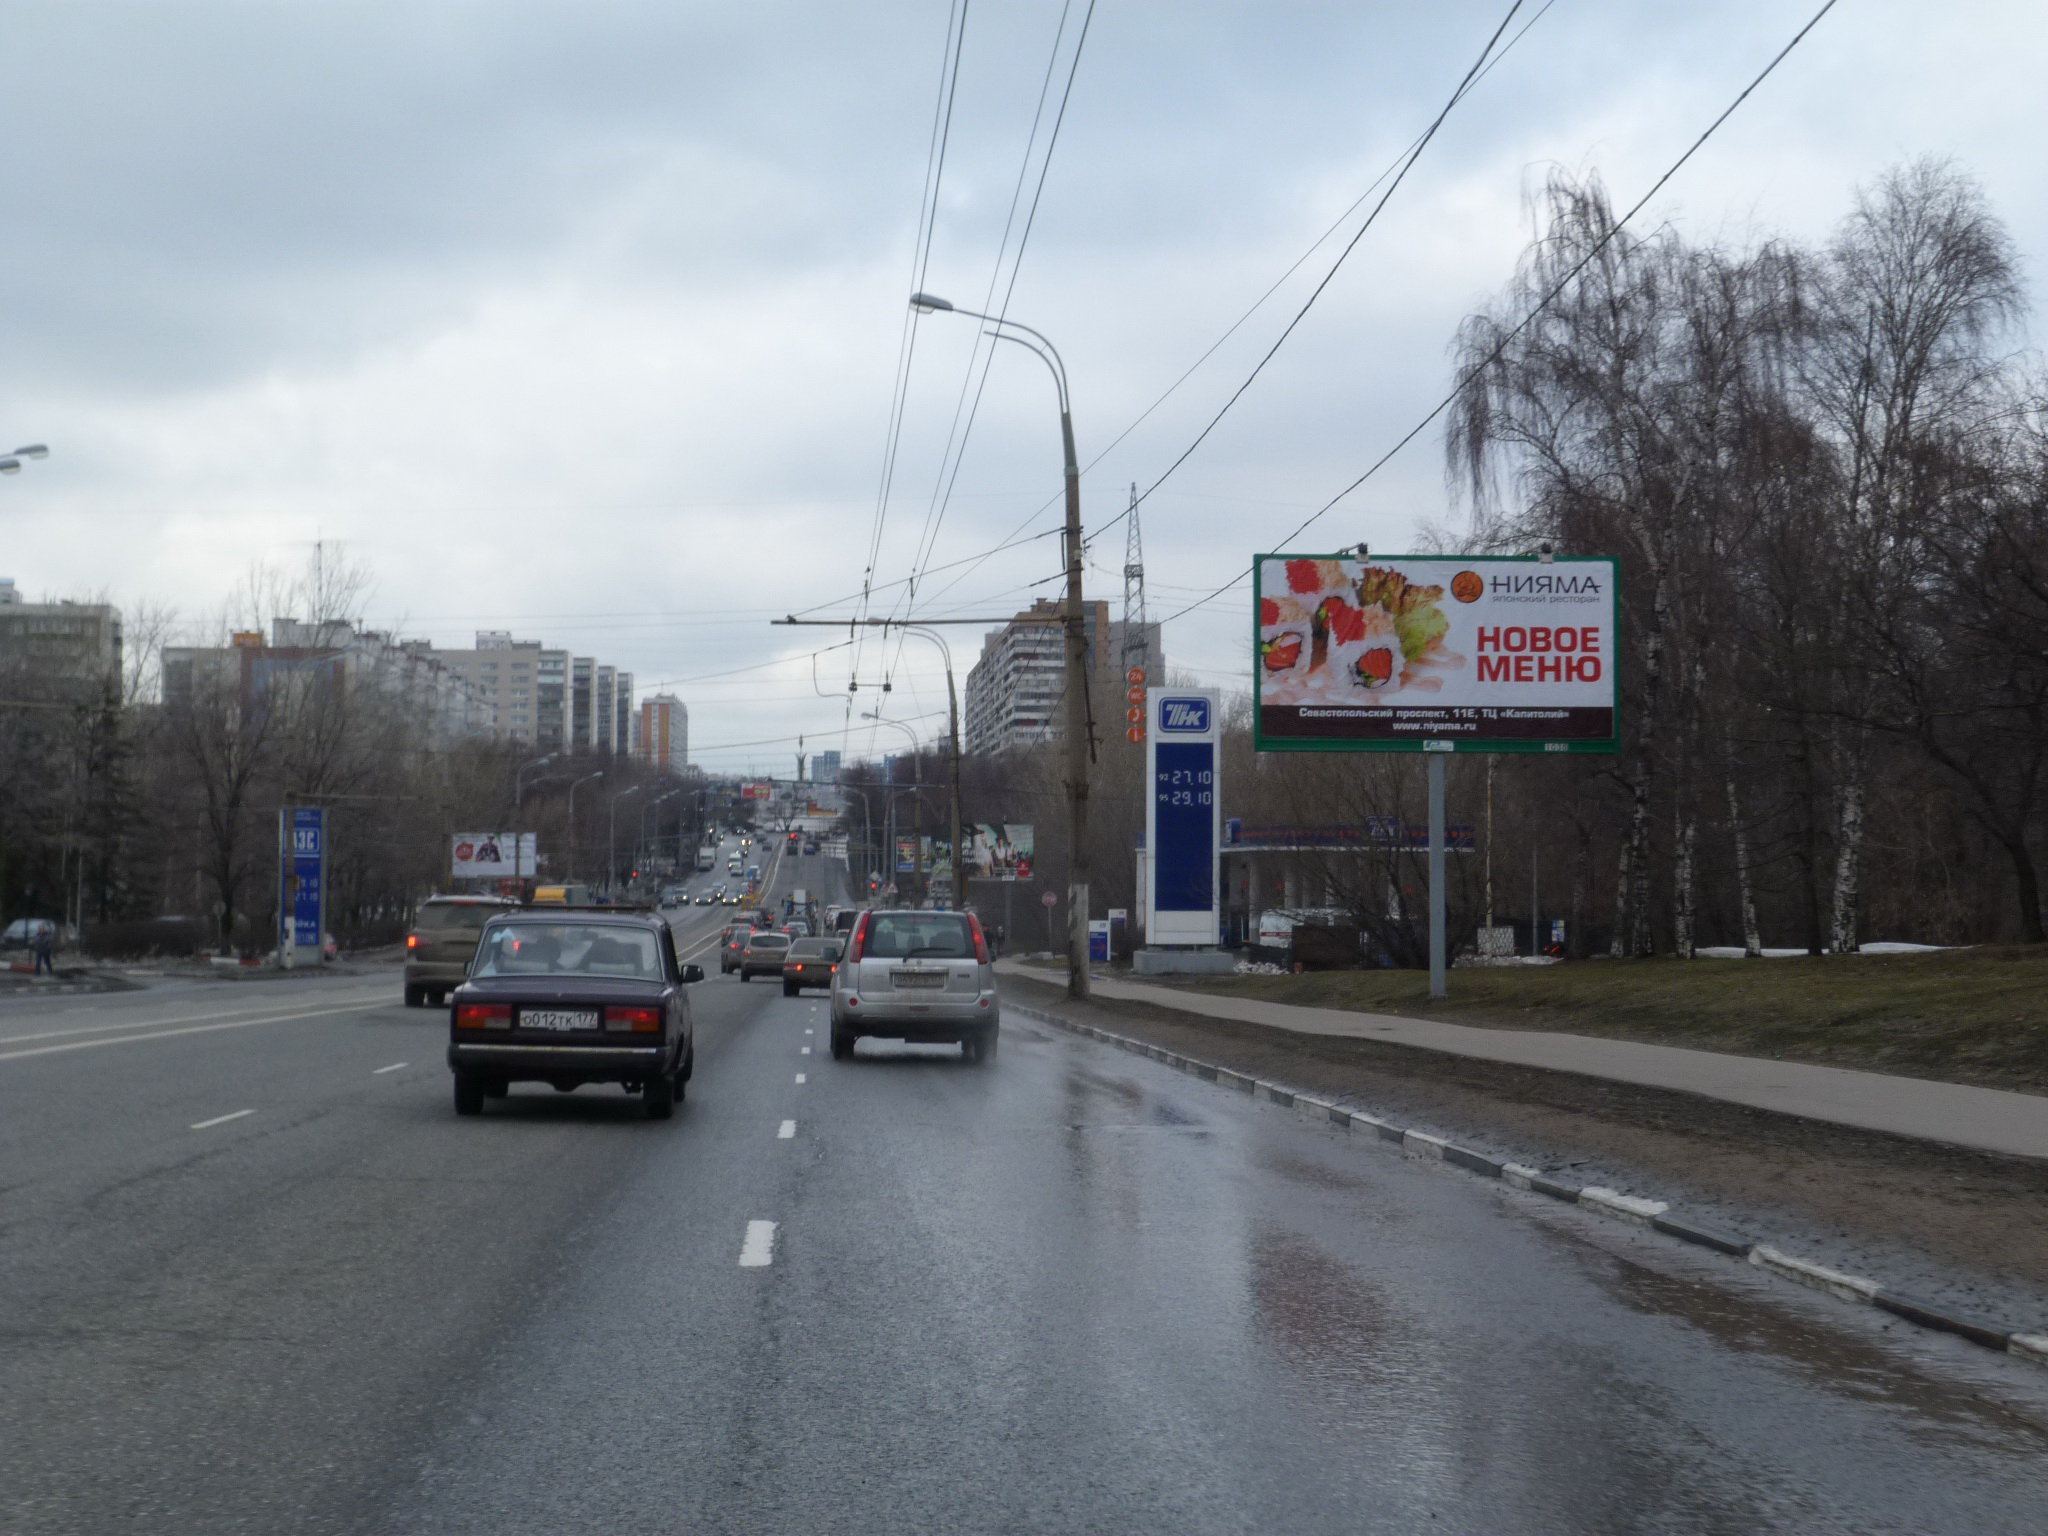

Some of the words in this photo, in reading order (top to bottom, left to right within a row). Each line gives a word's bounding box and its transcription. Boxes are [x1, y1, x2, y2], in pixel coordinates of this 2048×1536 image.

[1489, 576, 1602, 594] НИЯМА
[1492, 595, 1546, 604] японский
[1550, 596, 1600, 606] ресторан
[1477, 626, 1600, 653] НОВОЕ
[1477, 655, 1602, 682] МЕНЮ
[1165, 704, 1204, 726] ТНК
[1299, 707, 1393, 718] Севастопольский
[1396, 709, 1449, 719] проспект,
[1481, 708, 1497, 719] ТЦ
[1500, 708, 1570, 719] «Капитолий»
[1392, 721, 1477, 733] www.niyama.ru
[1159, 773, 1168, 782] 92
[1172, 770, 1211, 786] 27.10
[1172, 790, 1211, 806] 29.10
